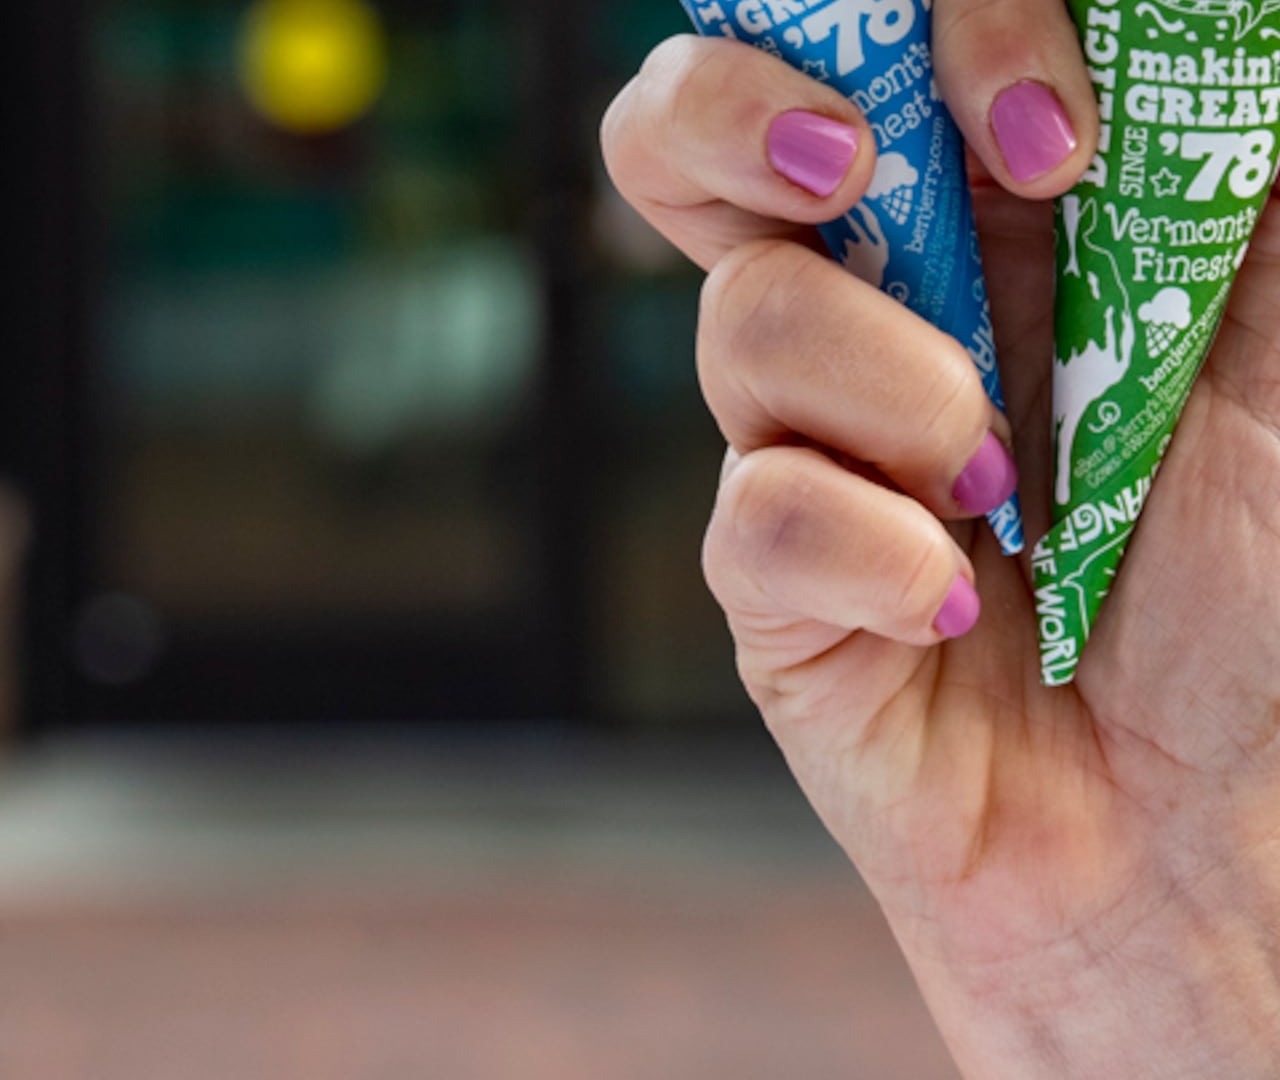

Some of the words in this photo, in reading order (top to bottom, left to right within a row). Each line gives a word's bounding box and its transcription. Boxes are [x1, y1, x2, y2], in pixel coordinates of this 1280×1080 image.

[1126, 46, 1280, 86] makin'
[1120, 126, 1149, 199] SINCE
[1158, 128, 1277, 202] '78
[1132, 246, 1233, 284] Finest
